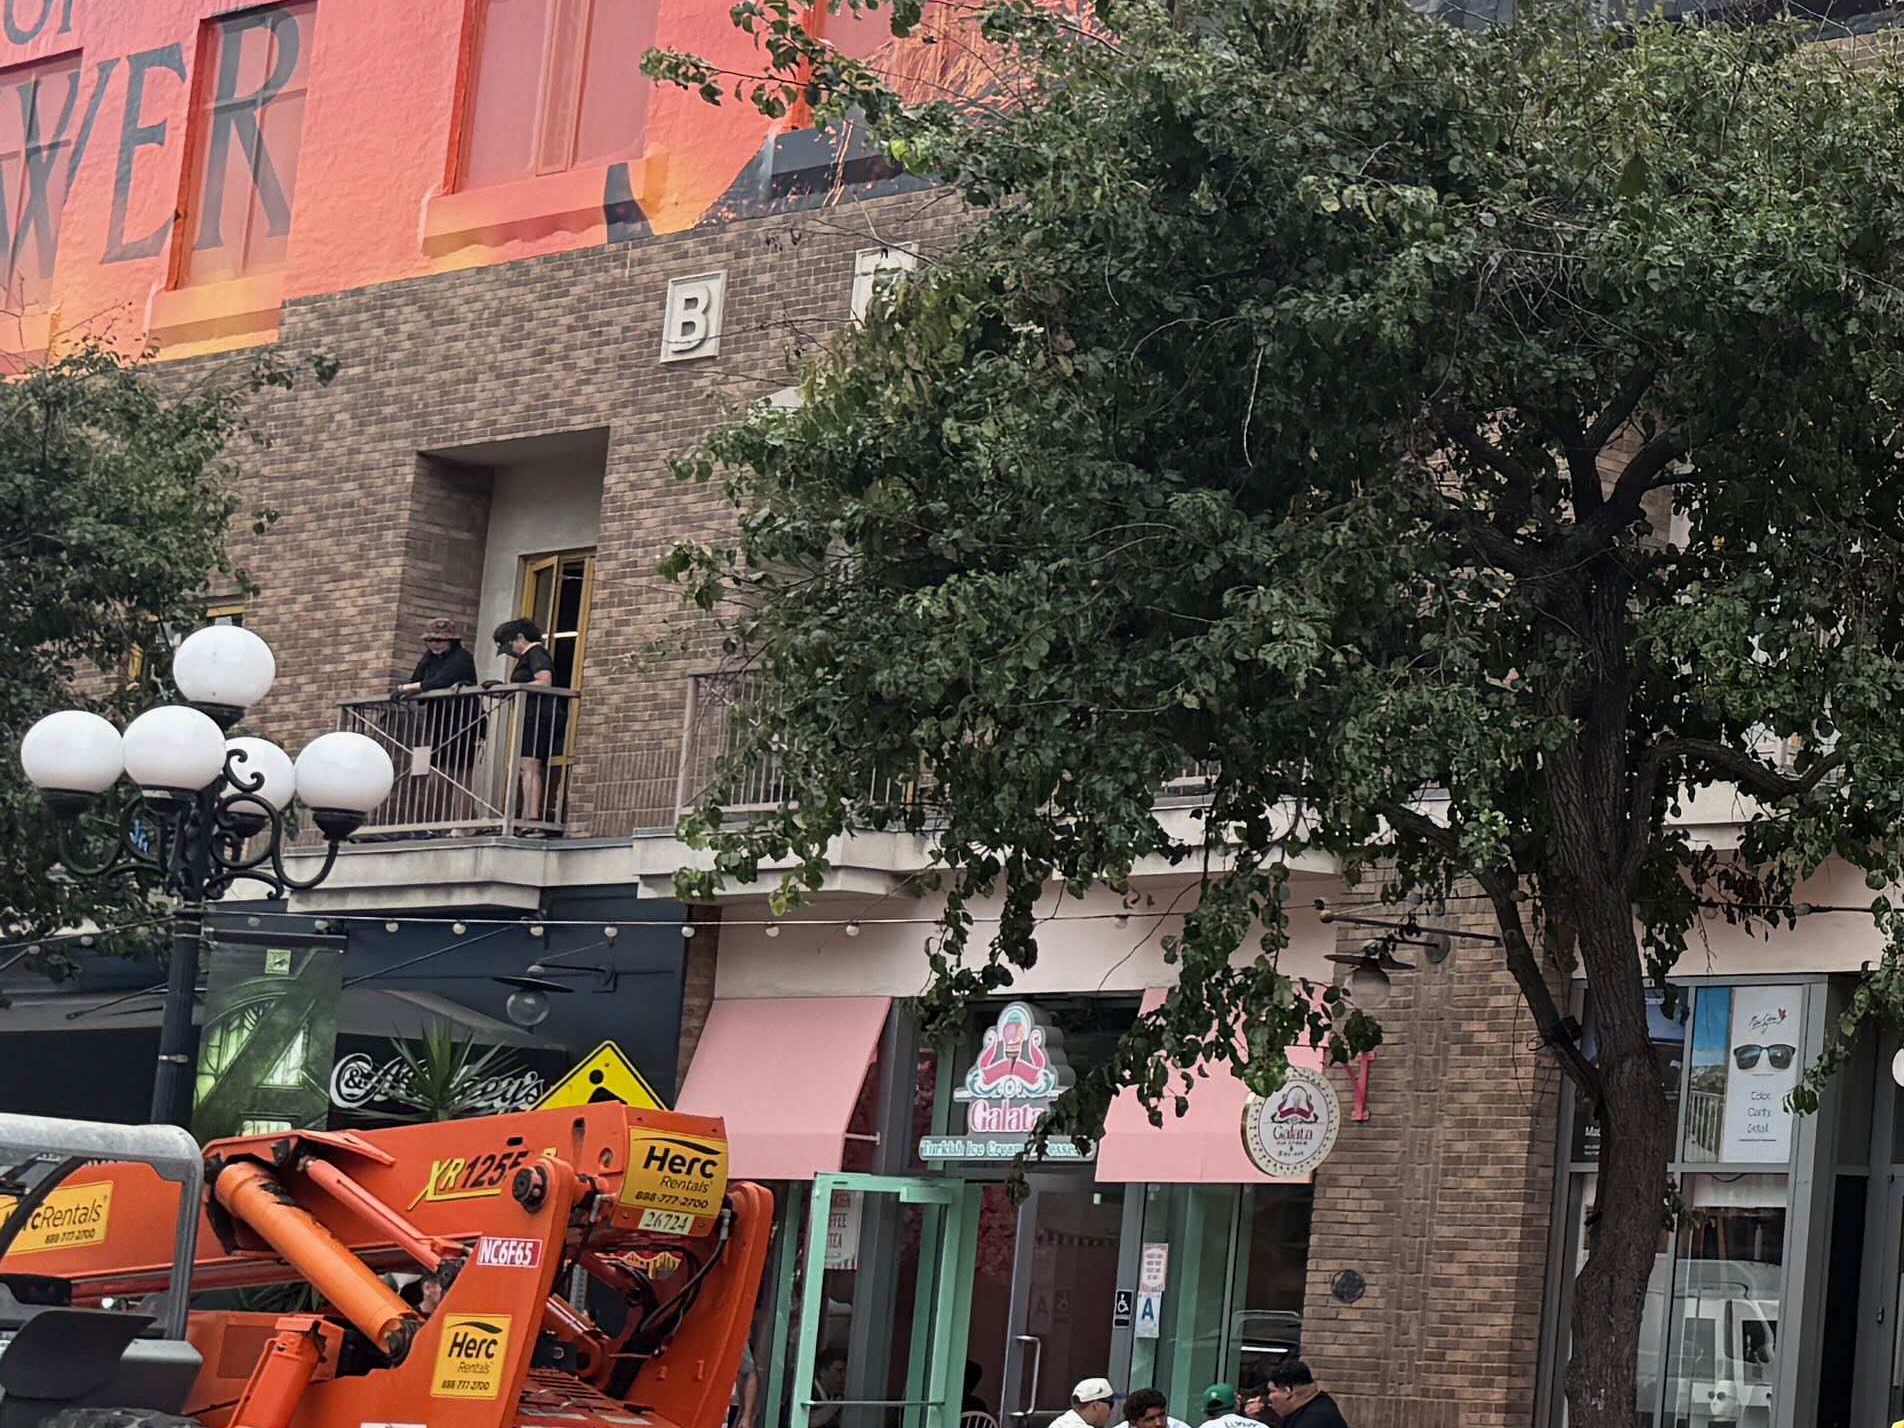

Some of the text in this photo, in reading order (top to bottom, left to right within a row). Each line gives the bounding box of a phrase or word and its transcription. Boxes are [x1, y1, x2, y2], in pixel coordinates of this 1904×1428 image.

[970, 1098, 1044, 1133] Galata
[643, 1145, 718, 1179] Herc
[660, 1175, 711, 1194] Rentals
[27, 1198, 103, 1230] cRentals
[644, 1211, 690, 1232] 26724
[478, 1236, 533, 1267] NC6F65
[1141, 1297, 1155, 1321] A
[448, 1332, 498, 1360] Herc
[457, 1361, 491, 1375] Rentals
